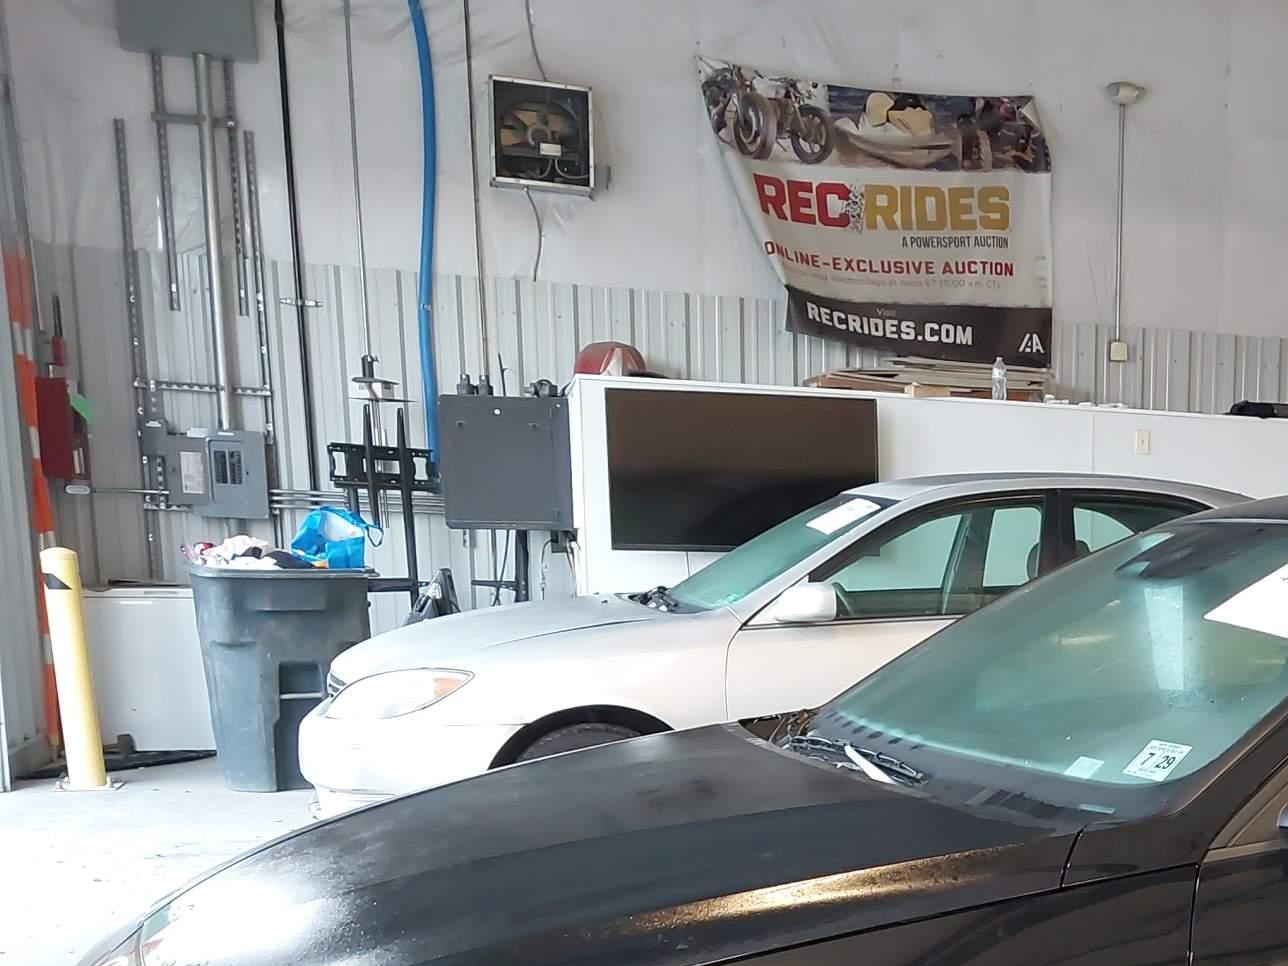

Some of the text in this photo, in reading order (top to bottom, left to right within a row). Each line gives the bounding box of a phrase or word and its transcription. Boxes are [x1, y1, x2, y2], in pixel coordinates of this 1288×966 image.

[753, 173, 1010, 231] REC RIDES
[902, 236, 1009, 248] A POWERSPORT AUCTION
[764, 241, 935, 275] ONLINE-EXCLUSIVE
[942, 260, 1014, 277] AUCTION
[806, 301, 973, 346] RECRIDES.COM
[876, 307, 897, 317] Visit
[1154, 755, 1177, 770] 29
